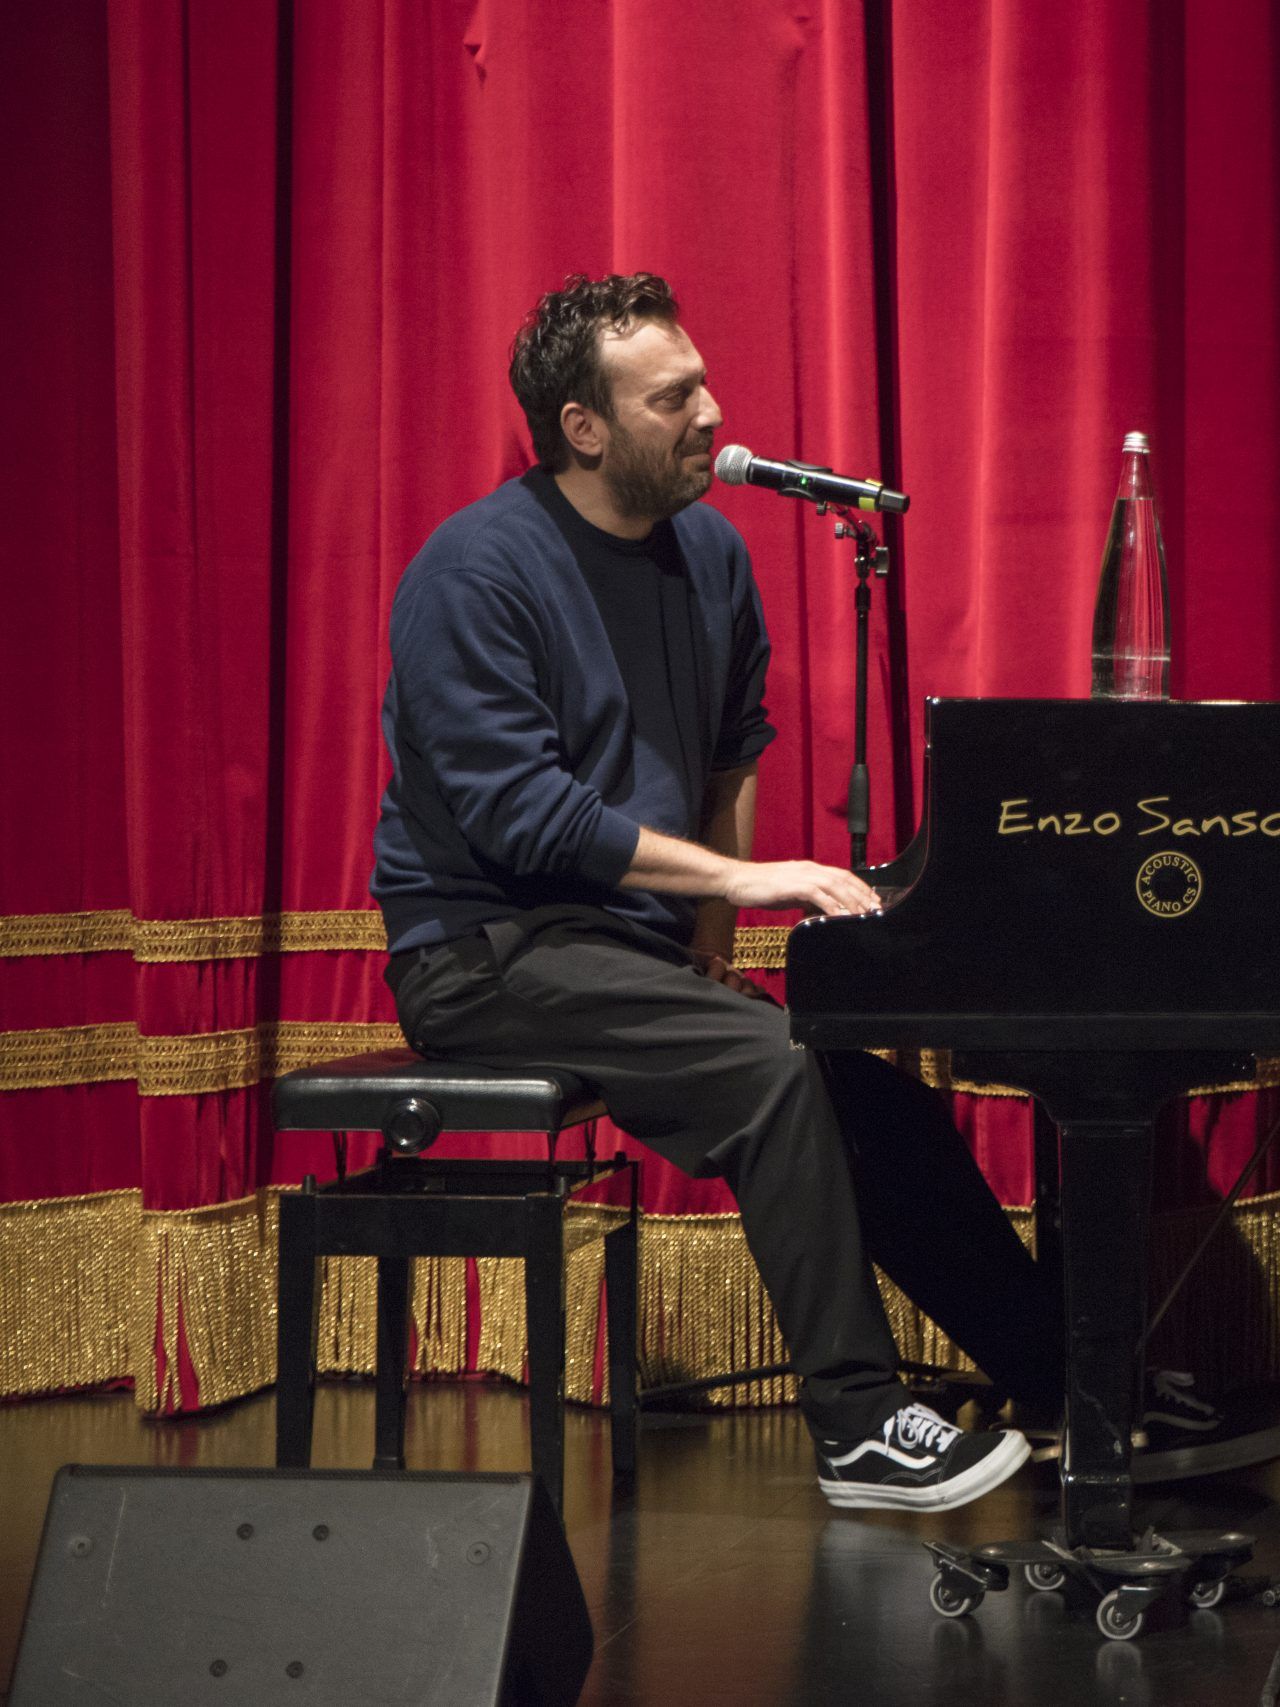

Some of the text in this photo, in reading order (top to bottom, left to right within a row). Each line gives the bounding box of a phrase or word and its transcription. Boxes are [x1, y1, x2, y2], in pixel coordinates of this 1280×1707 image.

[998, 799, 1121, 836] Enzo
[1141, 856, 1198, 886] ACOUSTIC
[1142, 887, 1197, 912] PIANO CS
